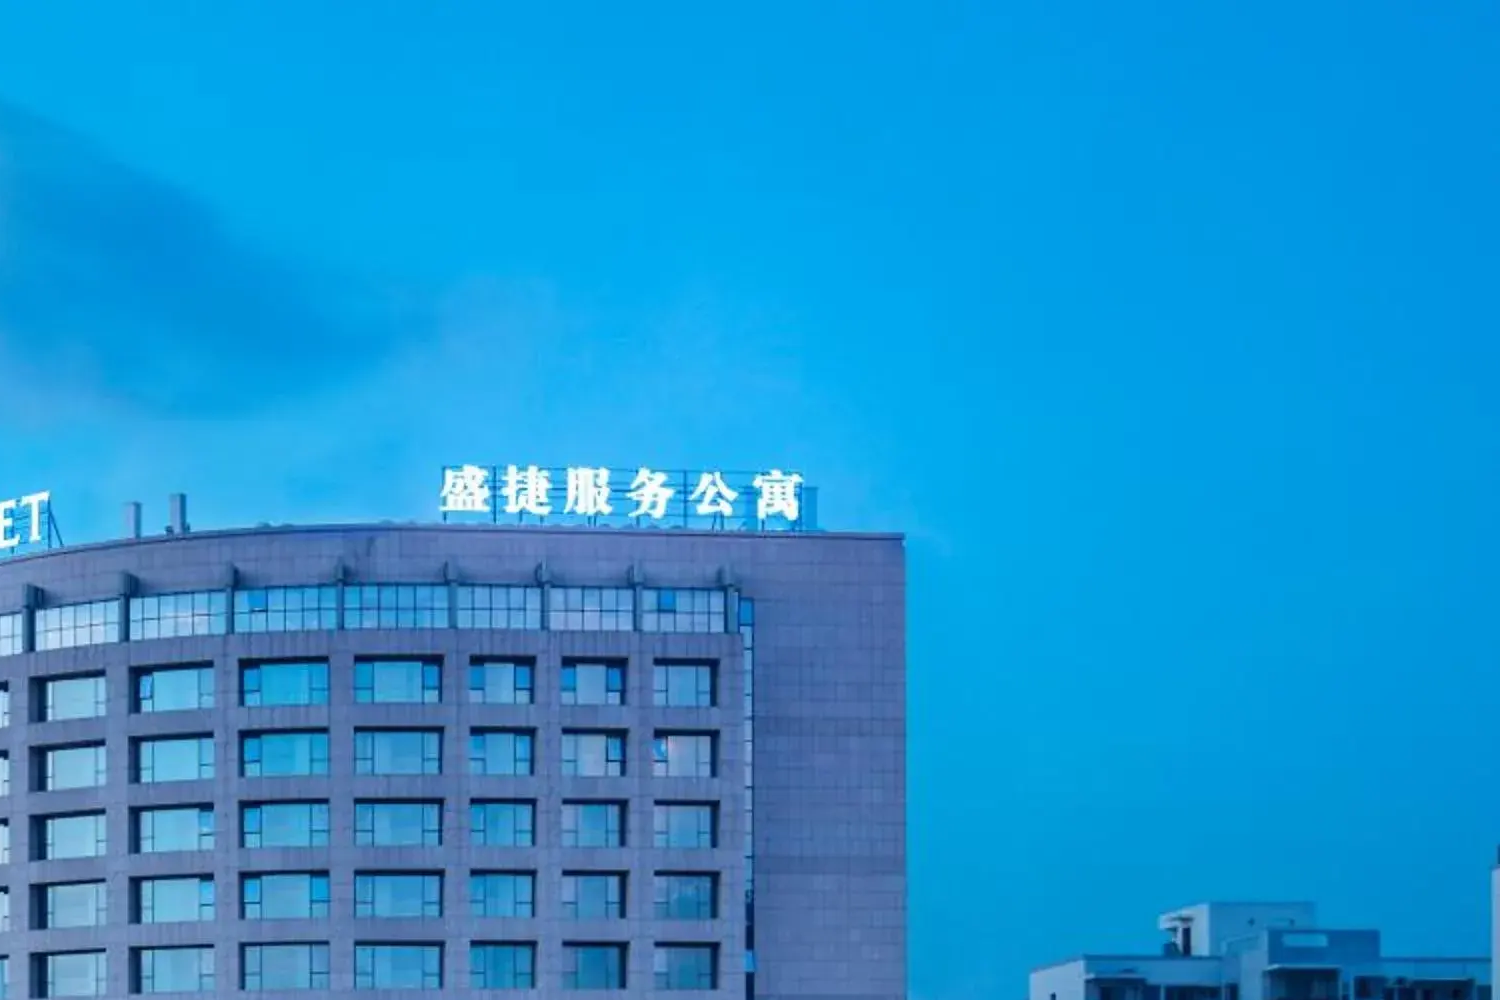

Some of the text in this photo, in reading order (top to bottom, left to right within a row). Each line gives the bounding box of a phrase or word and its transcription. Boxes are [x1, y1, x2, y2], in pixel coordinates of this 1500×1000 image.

[439, 464, 803, 521] 盛捷服务公寓
